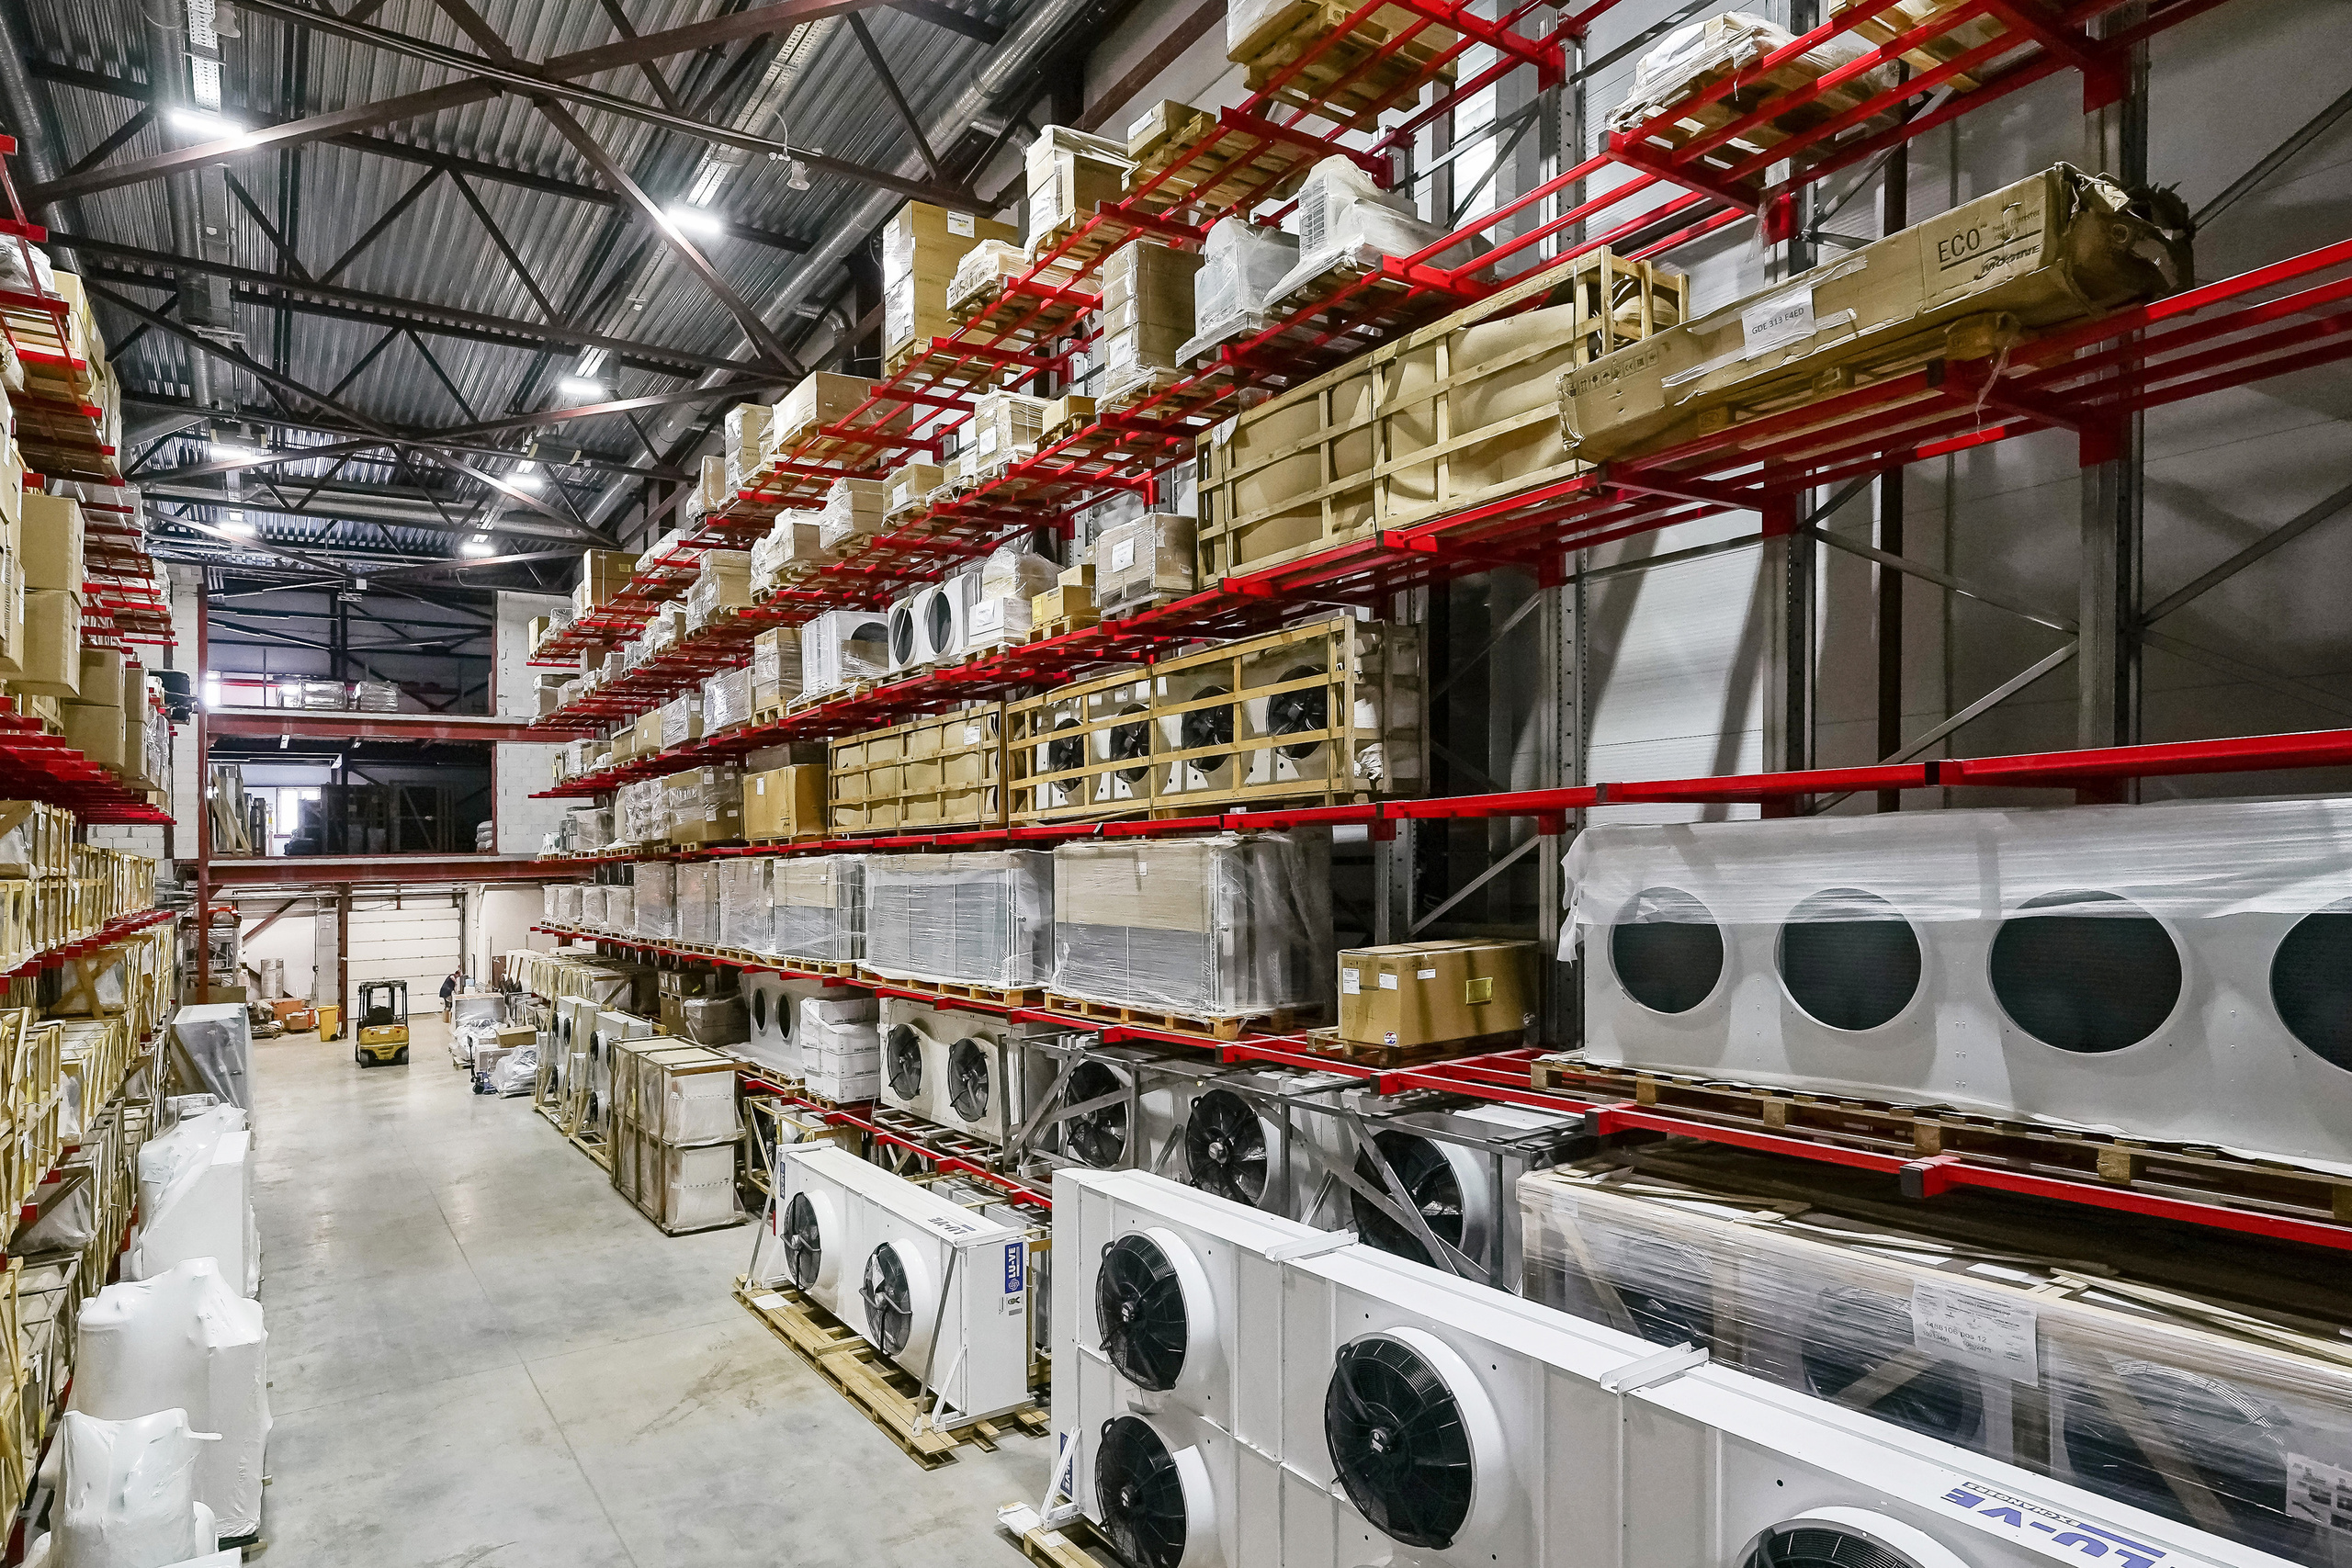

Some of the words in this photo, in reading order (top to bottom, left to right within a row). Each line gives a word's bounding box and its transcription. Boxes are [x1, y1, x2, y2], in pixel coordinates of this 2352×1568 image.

[1751, 322, 1768, 334] GDE
[1769, 317, 1783, 327] 313
[1008, 1247, 1016, 1279] LU-VE
[1977, 1335, 1987, 1343] 12
